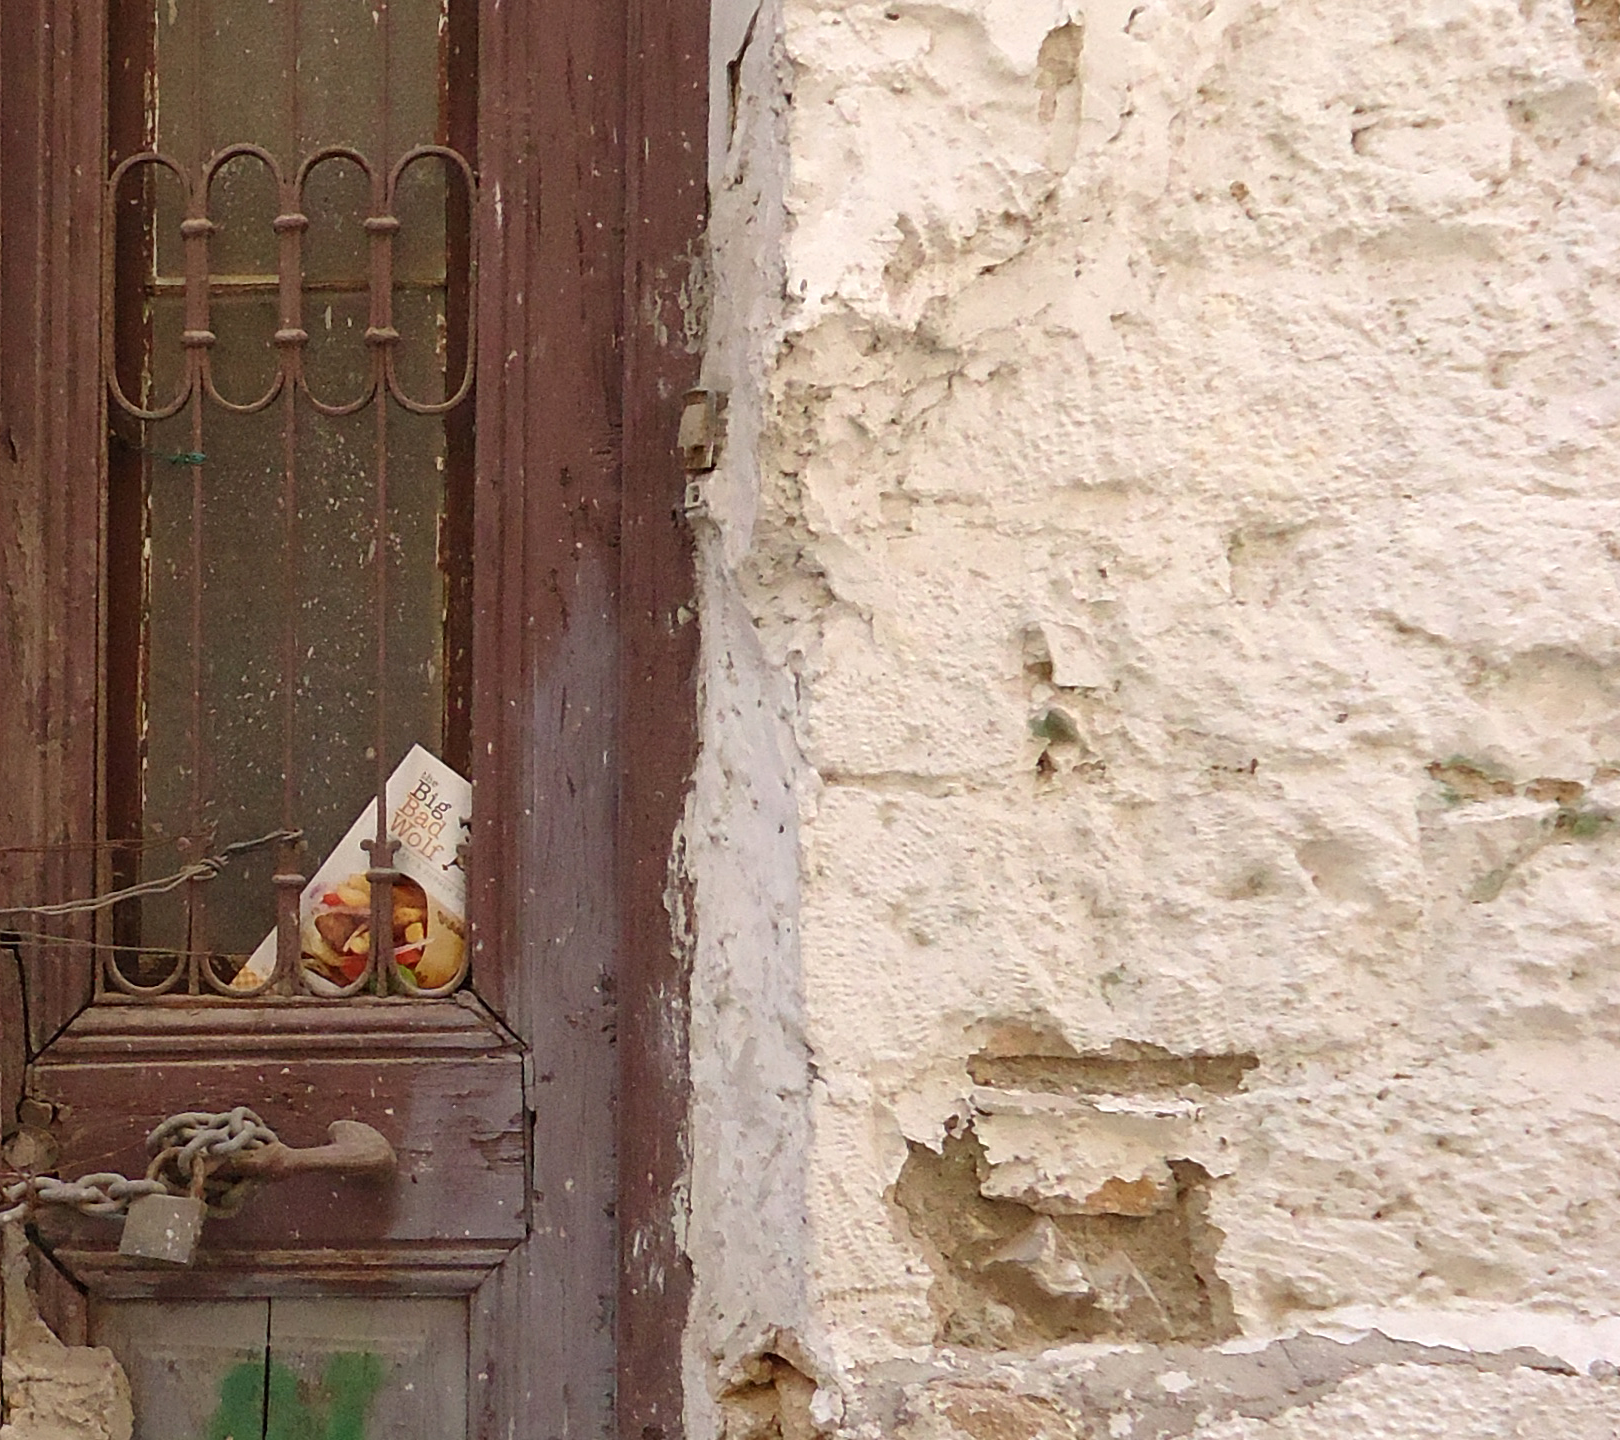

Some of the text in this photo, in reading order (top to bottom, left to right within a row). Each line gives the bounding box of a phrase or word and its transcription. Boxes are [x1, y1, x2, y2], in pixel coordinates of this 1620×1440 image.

[409, 779, 452, 820] Big
[420, 770, 439, 788] the
[390, 810, 445, 861] Wolf
[398, 793, 447, 840] Bad
